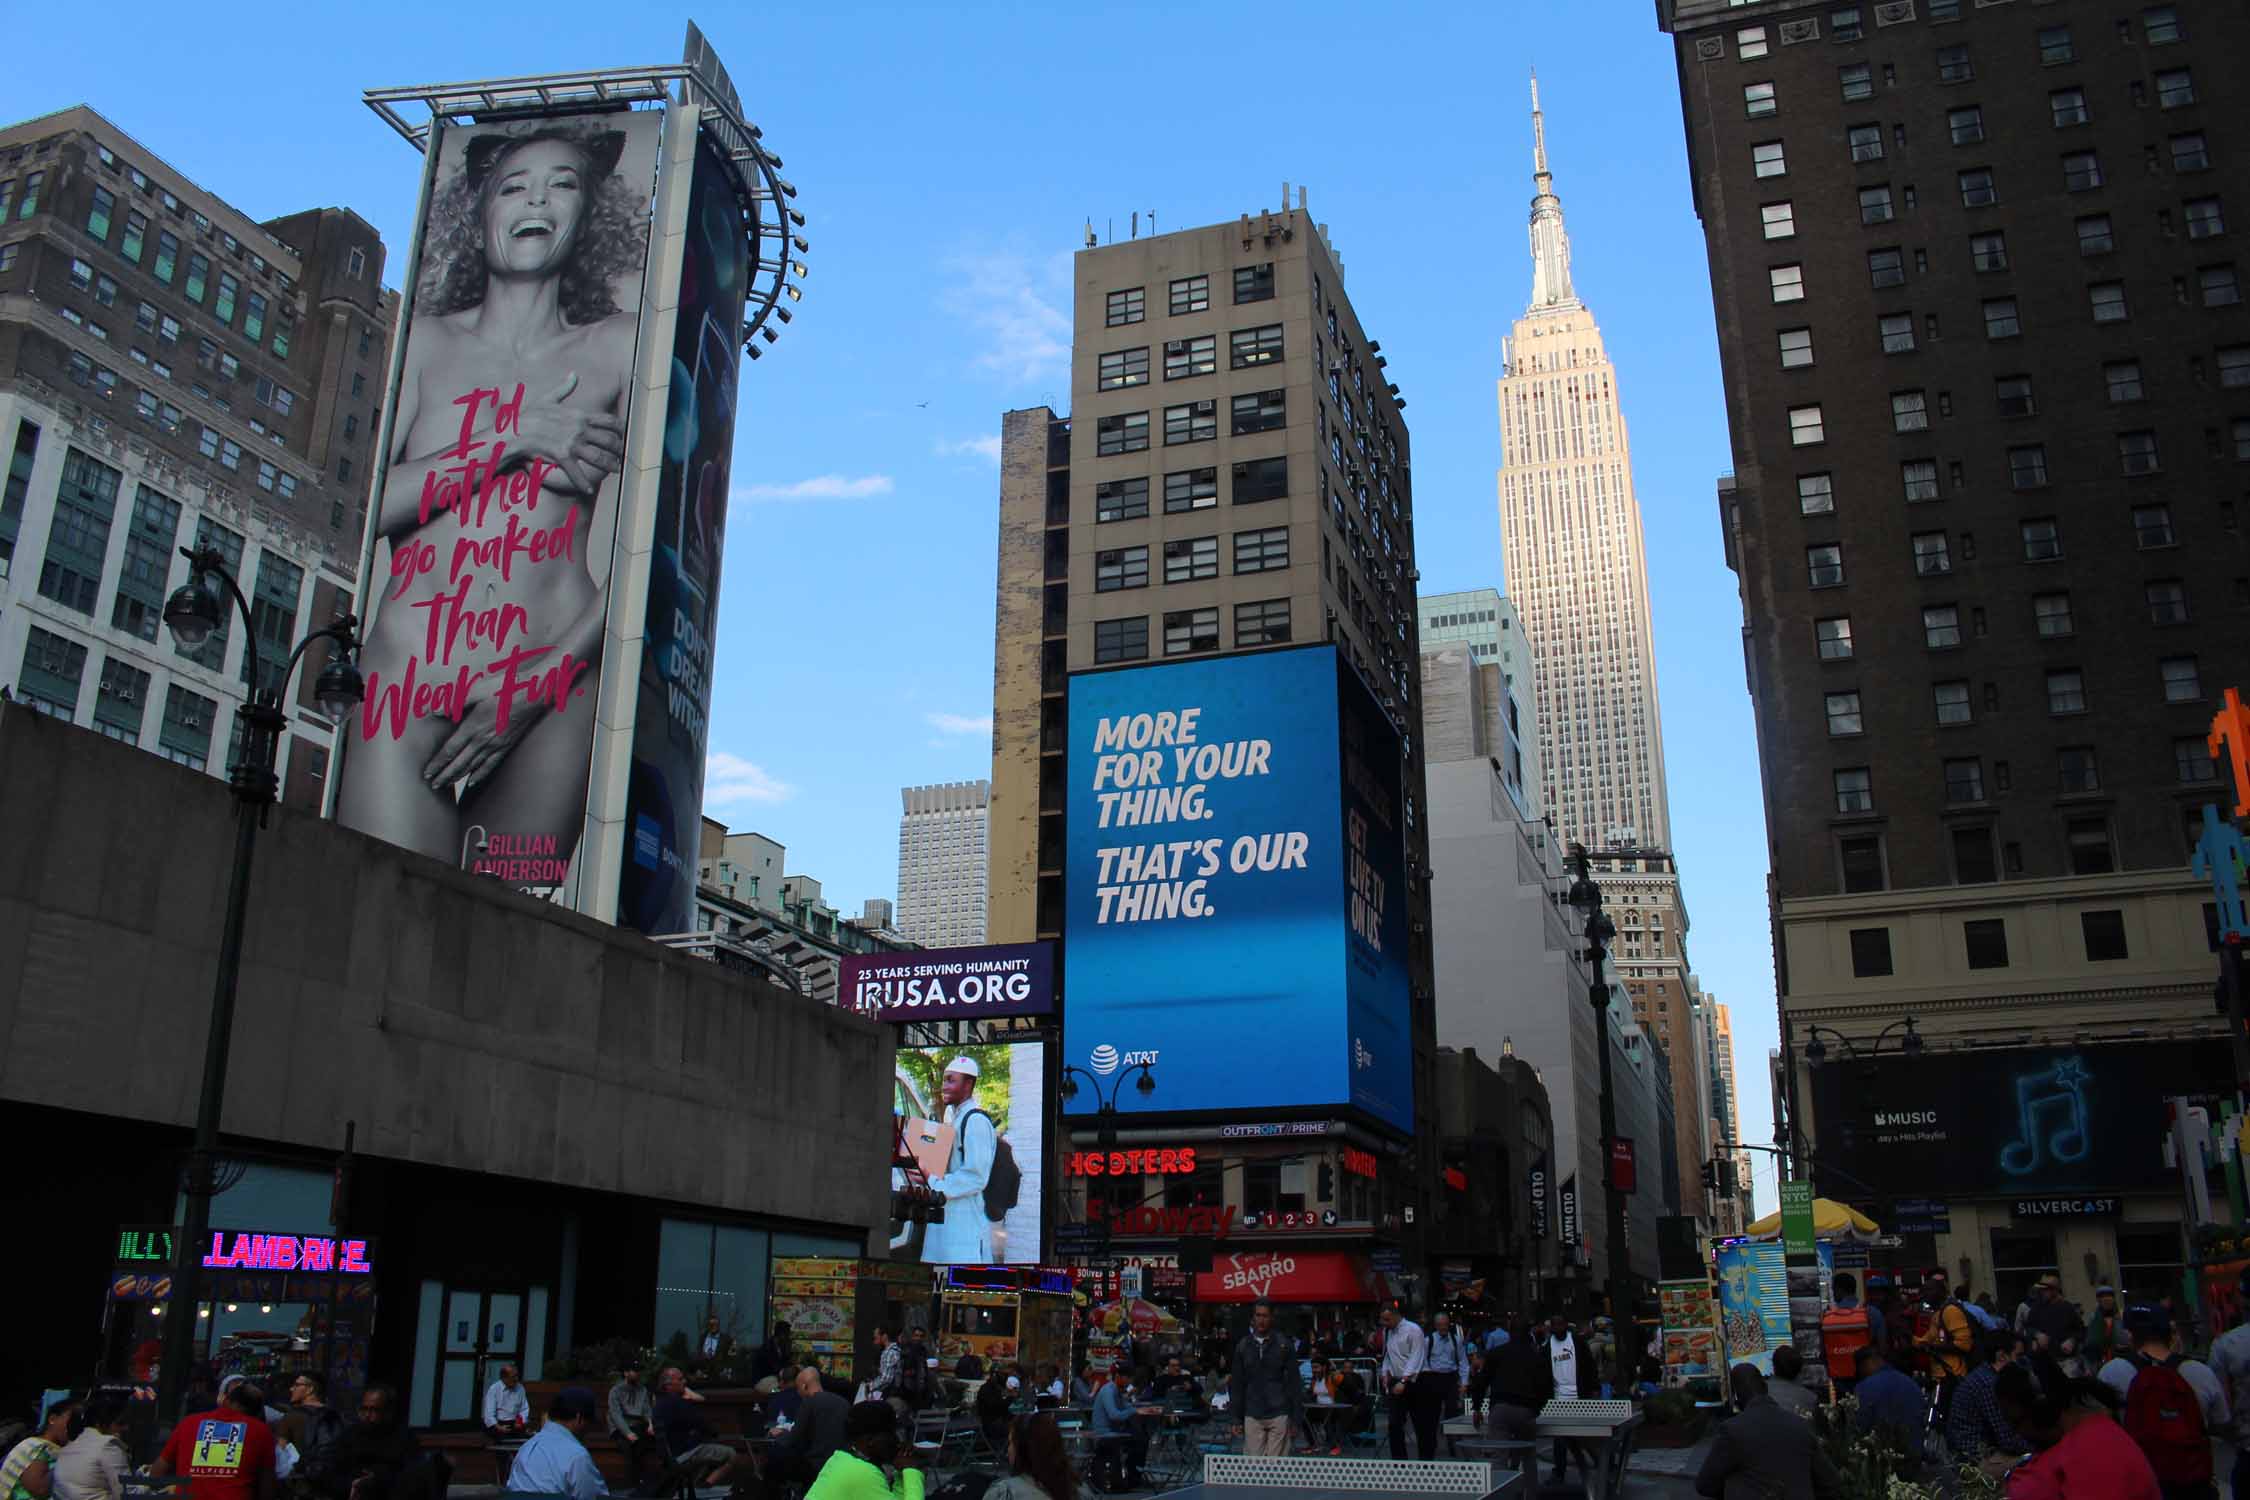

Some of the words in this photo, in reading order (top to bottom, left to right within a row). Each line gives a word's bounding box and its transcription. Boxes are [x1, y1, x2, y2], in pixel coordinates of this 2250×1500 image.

[437, 382, 526, 460] I'd
[418, 441, 559, 528] rather
[391, 538, 436, 600] go
[450, 504, 579, 584] naked
[487, 645, 588, 736] Fur.
[1093, 708, 1201, 752] MORE
[1093, 751, 1163, 791] FOR
[1175, 739, 1272, 783] YOUR
[1096, 784, 1214, 829] THING.
[488, 834, 557, 857] GILLIAN
[1096, 838, 1223, 885] THAT'S
[1230, 832, 1309, 874] OUR
[1096, 880, 1215, 925] THING.
[858, 969, 872, 981] 25
[875, 967, 911, 979] YEARS
[913, 963, 963, 977] SERVING
[966, 959, 1031, 973] HUMANITY
[856, 973, 1031, 1009] IRUSA.ORG
[1123, 1050, 1160, 1065] AT&T
[1888, 1111, 1937, 1125] MUSIC
[1063, 1147, 1197, 1177] HOOTERS
[1531, 1171, 1544, 1198] OLD
[1267, 1214, 1273, 1225] 1
[1286, 1213, 1295, 1225] 2
[1306, 1213, 1315, 1225] 3
[1563, 1192, 1574, 1214] OLD
[2018, 1200, 2113, 1215] SILVERCAST
[1223, 1258, 1296, 1290] SBARRO
